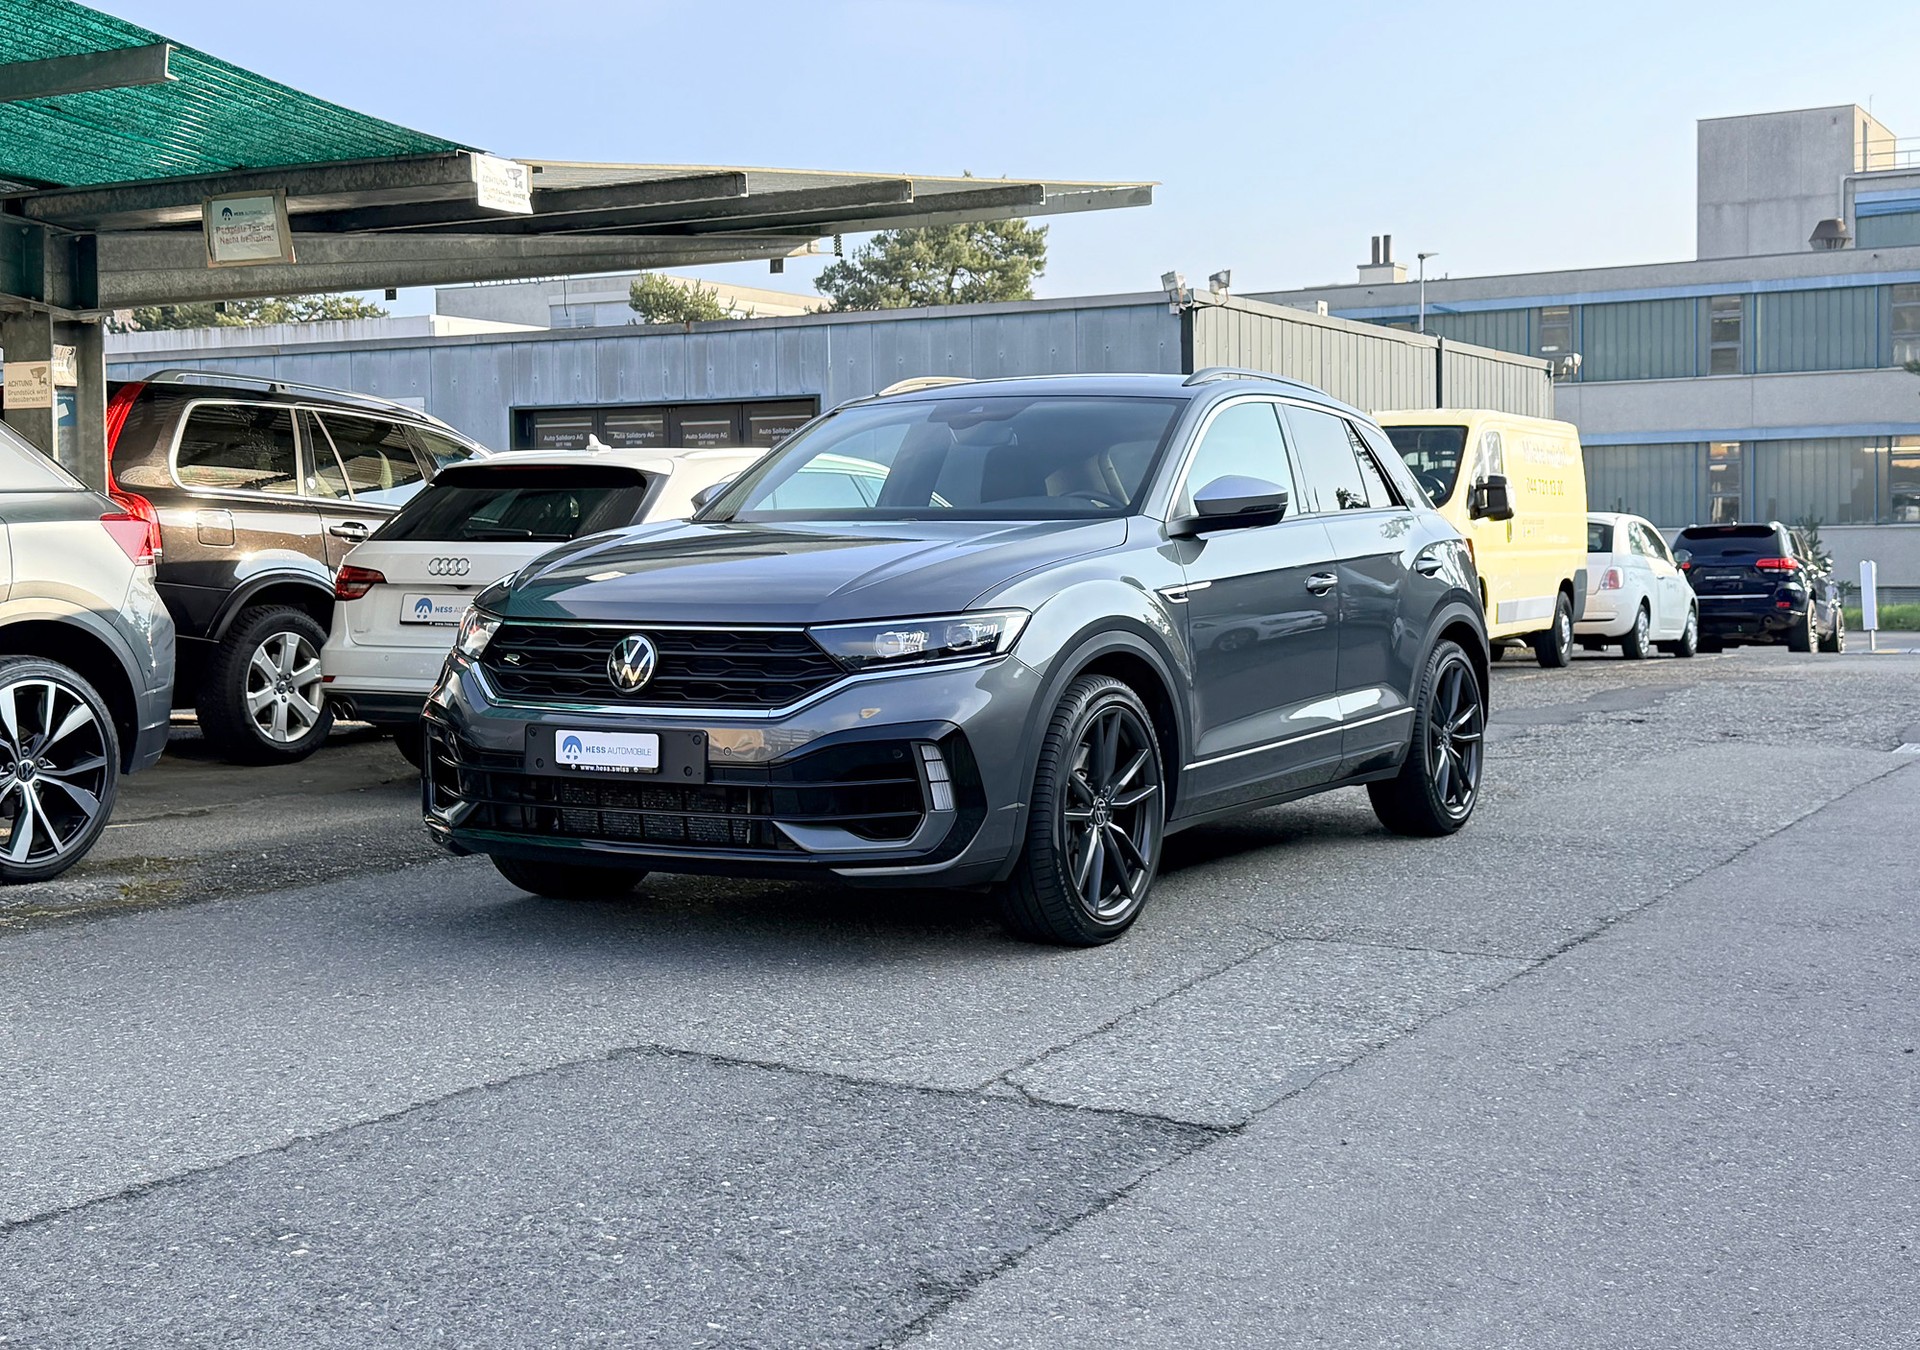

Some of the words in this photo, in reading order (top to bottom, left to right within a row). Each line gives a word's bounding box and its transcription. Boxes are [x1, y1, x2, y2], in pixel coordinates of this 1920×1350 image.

[585, 746, 606, 754] HESS
[607, 747, 652, 757] AUTOMOBILE
[580, 764, 630, 773] www.hess.swiss
